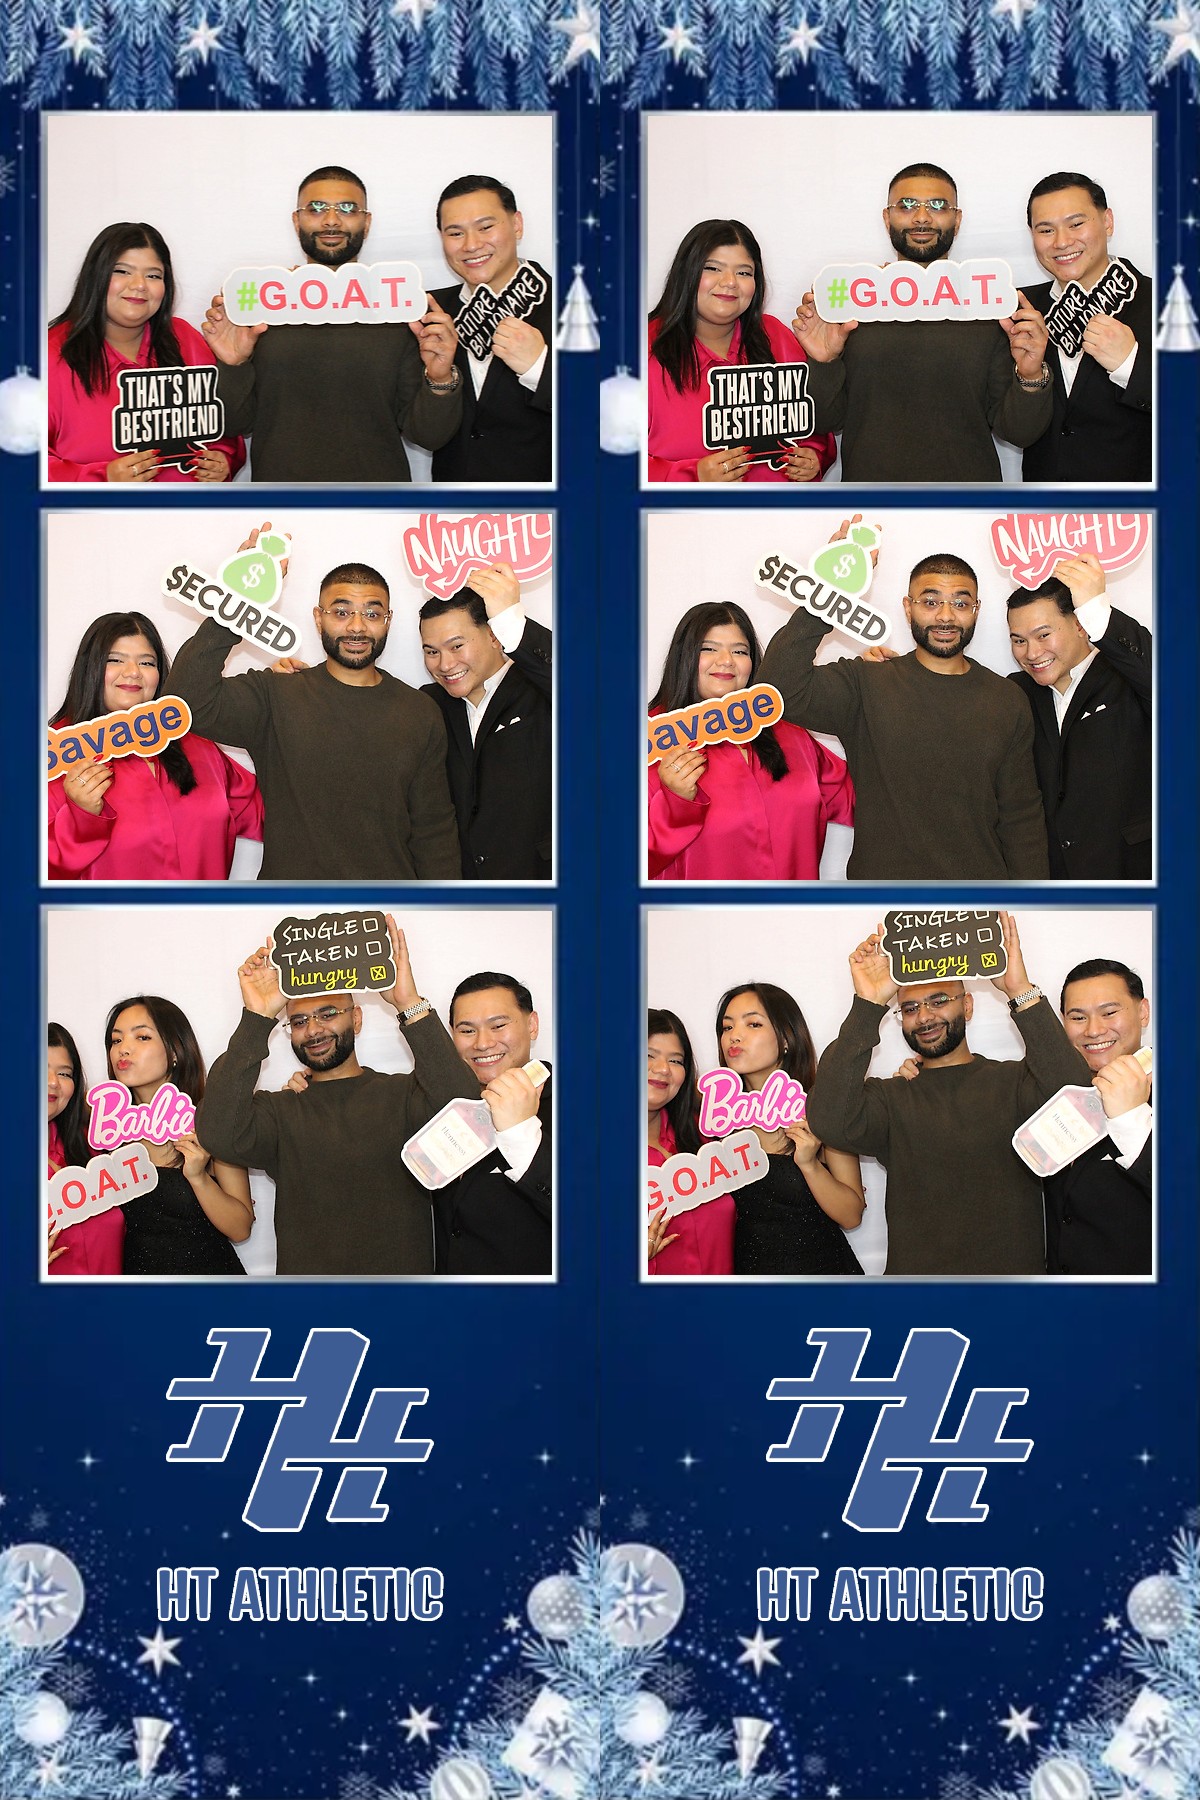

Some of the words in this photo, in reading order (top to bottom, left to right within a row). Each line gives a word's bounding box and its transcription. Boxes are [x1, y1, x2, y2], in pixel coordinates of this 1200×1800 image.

[236, 276, 412, 311] #G.O.A.T.
[827, 273, 1003, 309] #G.O.A.T.
[455, 290, 496, 344] FUTURE
[1046, 287, 1086, 341] FUTURE
[125, 373, 183, 409] THAT'S
[187, 372, 213, 404] MY
[715, 370, 774, 406] THAT'S
[778, 369, 803, 401] MY
[120, 404, 218, 445] BESTFRIEND
[710, 401, 809, 442] BESTFRIEND
[166, 564, 297, 652] $ECURED
[758, 555, 887, 641] $ECURED
[648, 693, 775, 754] avage
[282, 919, 359, 946] SINGLE
[893, 911, 970, 932] SINGLE
[281, 945, 358, 966] TAKEN
[892, 932, 969, 953] TAKEN
[290, 966, 358, 990] hungry
[901, 954, 969, 977] hungry
[92, 1086, 195, 1146] Barbie
[703, 1073, 805, 1133] Barbie
[48, 1156, 148, 1220] .O.A.T.
